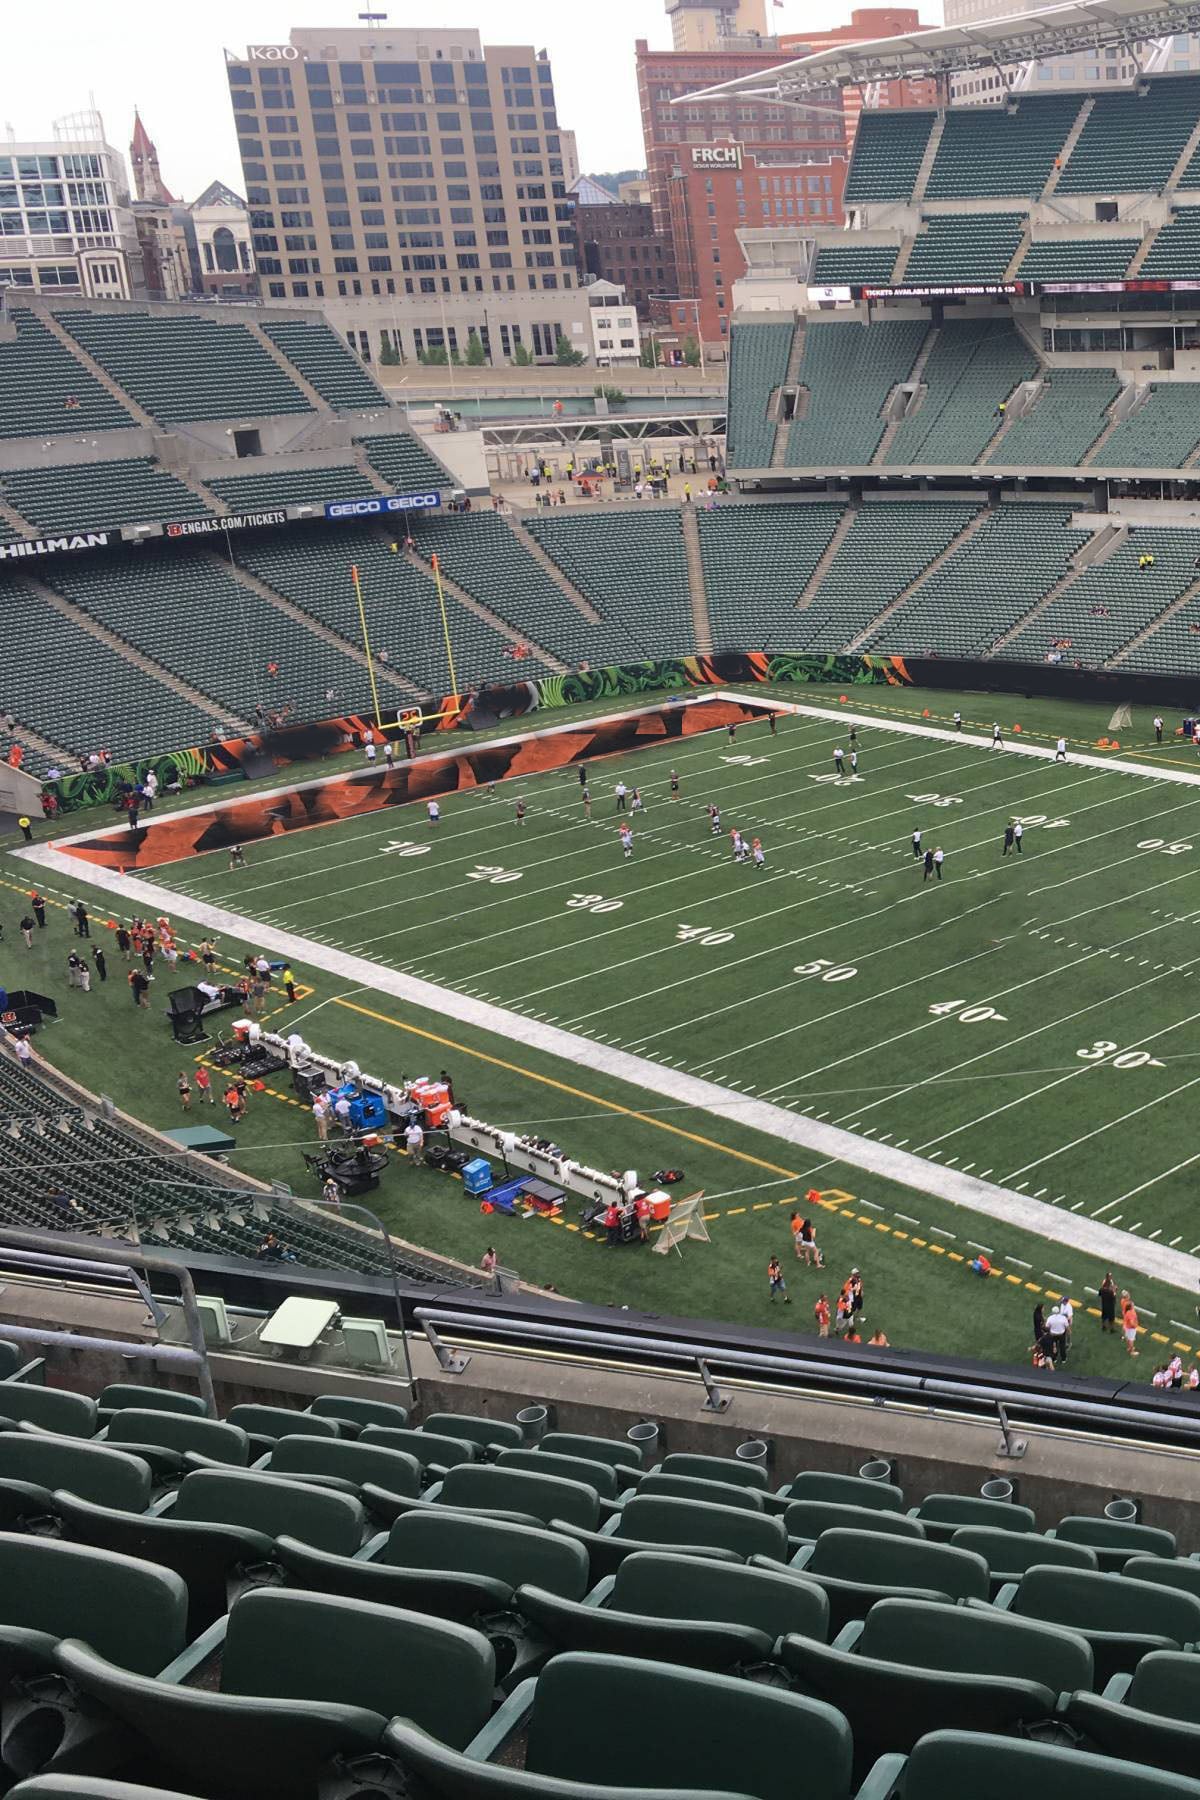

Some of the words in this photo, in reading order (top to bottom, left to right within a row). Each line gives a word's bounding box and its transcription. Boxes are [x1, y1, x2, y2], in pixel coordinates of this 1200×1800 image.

[692, 147, 736, 161] FRCH
[894, 288, 929, 296] AVAILABLE
[329, 501, 381, 516] GEICO
[387, 494, 437, 510] GEICO
[0, 532, 108, 559] HILLMAN
[380, 840, 431, 857] 10
[466, 865, 524, 884] 20
[566, 893, 624, 913] 30
[675, 923, 735, 946] 40
[793, 958, 858, 982] 50
[928, 999, 996, 1023] 40
[1076, 1040, 1151, 1069] 30
